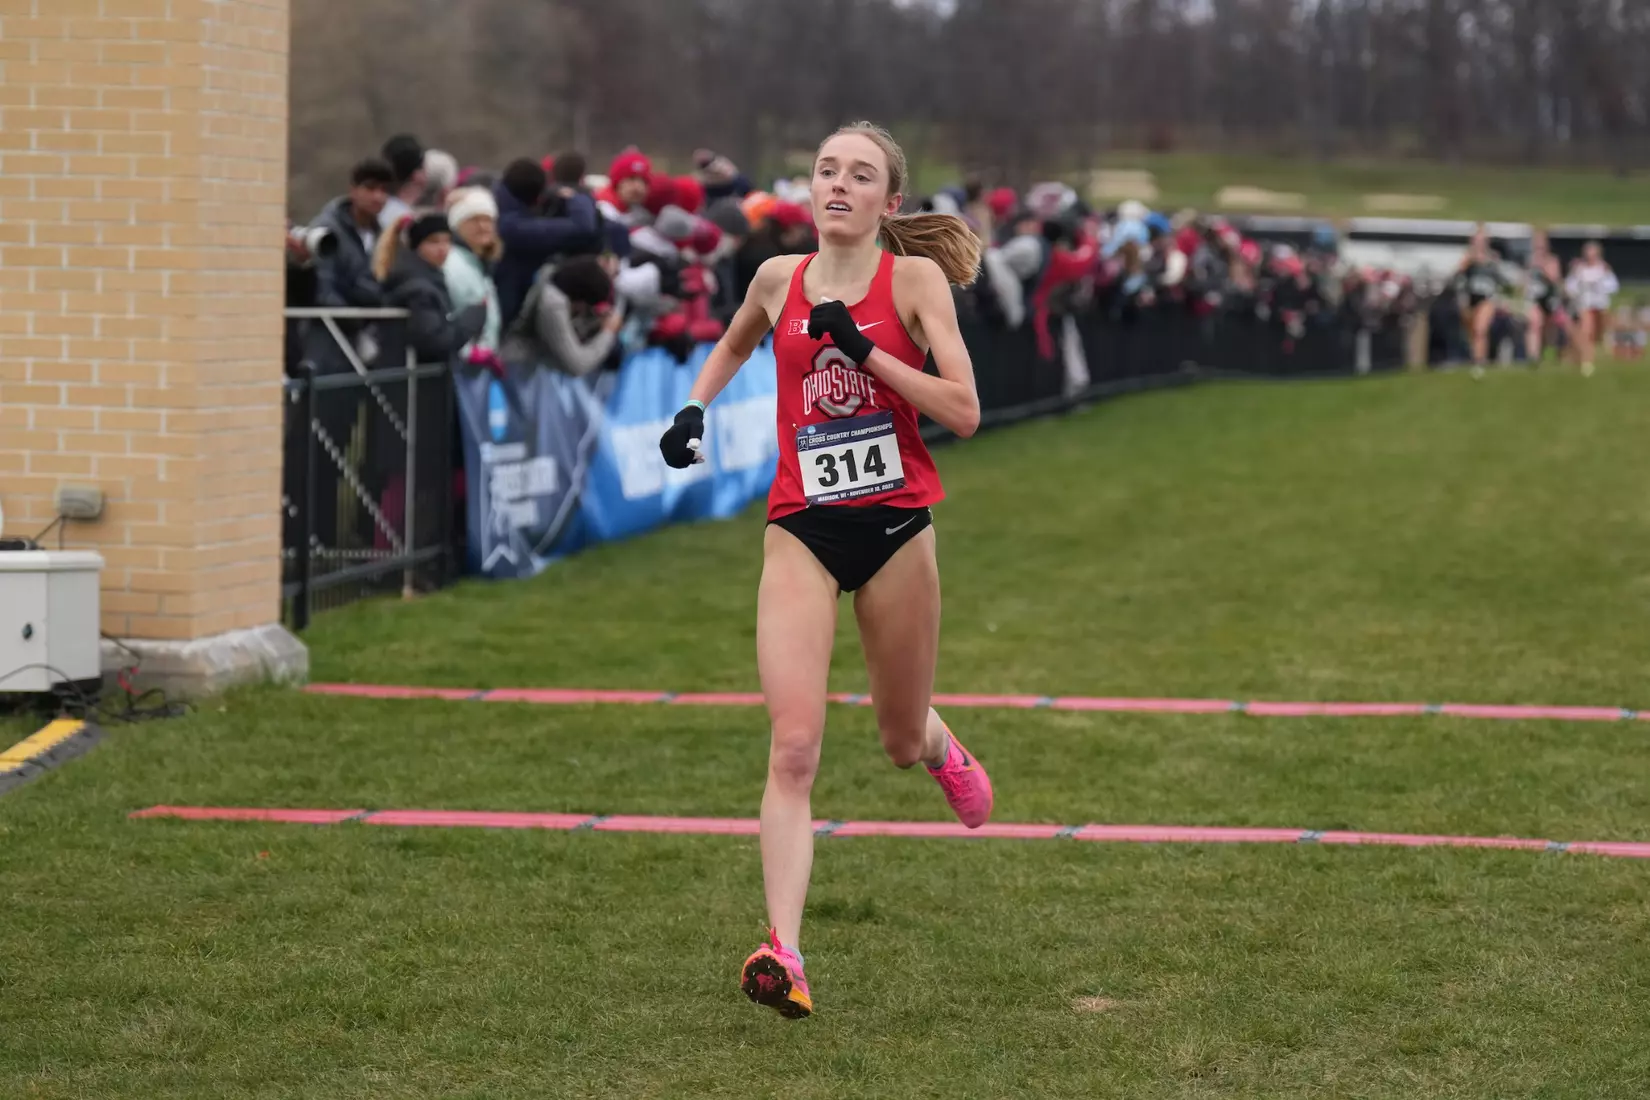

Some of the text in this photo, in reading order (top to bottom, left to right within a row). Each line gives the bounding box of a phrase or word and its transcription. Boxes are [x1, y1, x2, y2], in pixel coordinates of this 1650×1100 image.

[788, 319, 809, 335] BI
[808, 436, 826, 444] CROSS
[826, 431, 850, 441] COUNTRY
[850, 422, 893, 437] CHAMPIONSHIPS
[815, 444, 886, 487] 314
[849, 487, 874, 497] NOVEMBER
